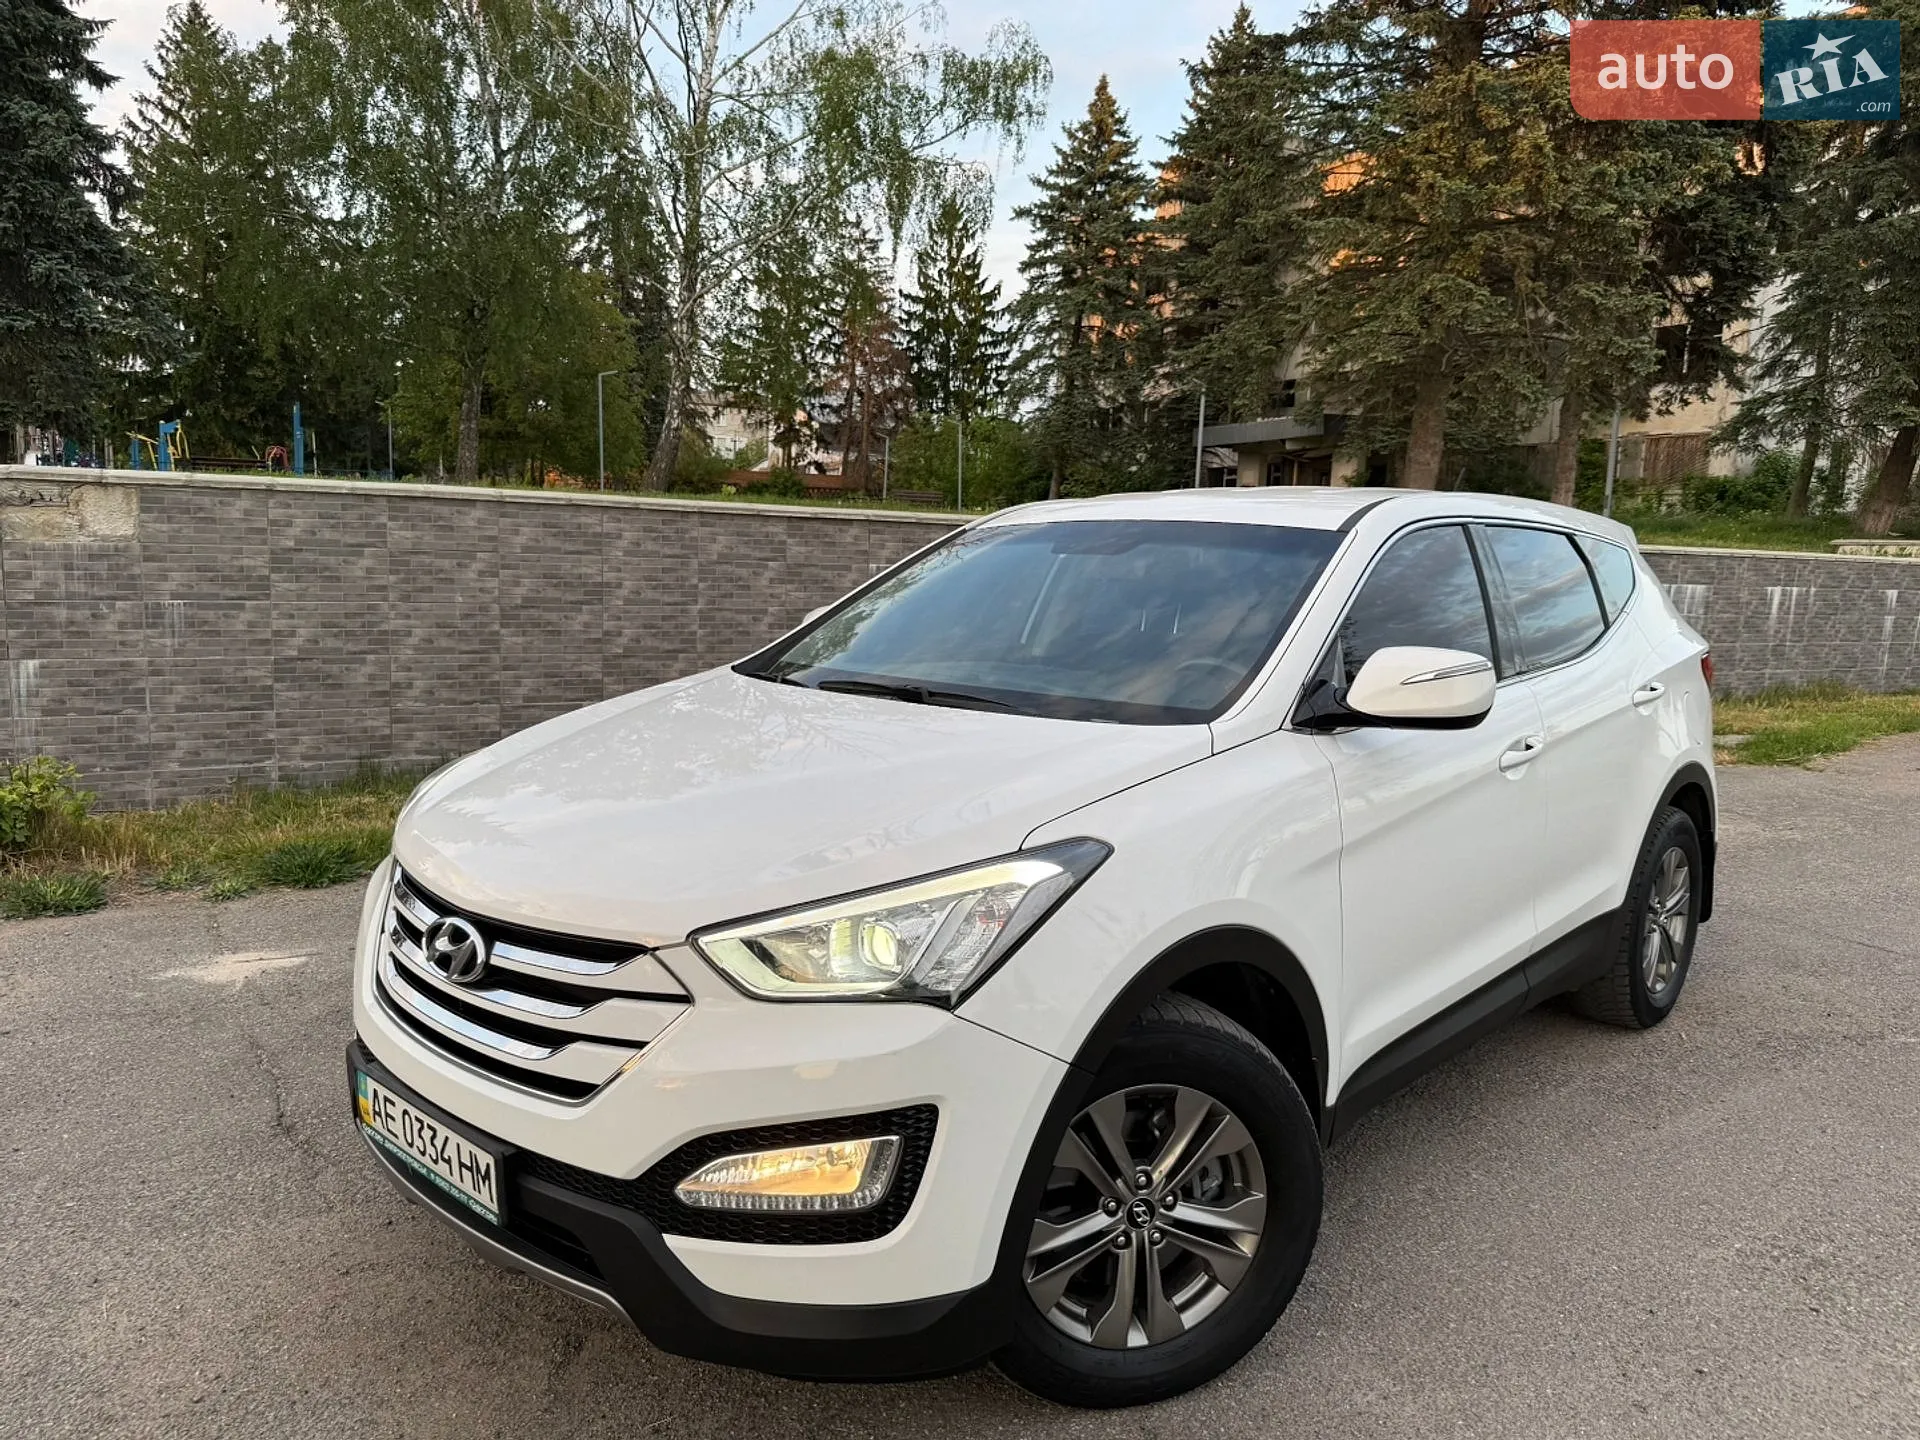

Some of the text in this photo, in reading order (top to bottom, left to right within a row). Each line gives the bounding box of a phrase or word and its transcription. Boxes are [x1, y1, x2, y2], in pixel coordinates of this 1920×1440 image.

[373, 1088, 399, 1140] AE
[402, 1109, 453, 1177] 0334
[456, 1142, 494, 1203] HM
